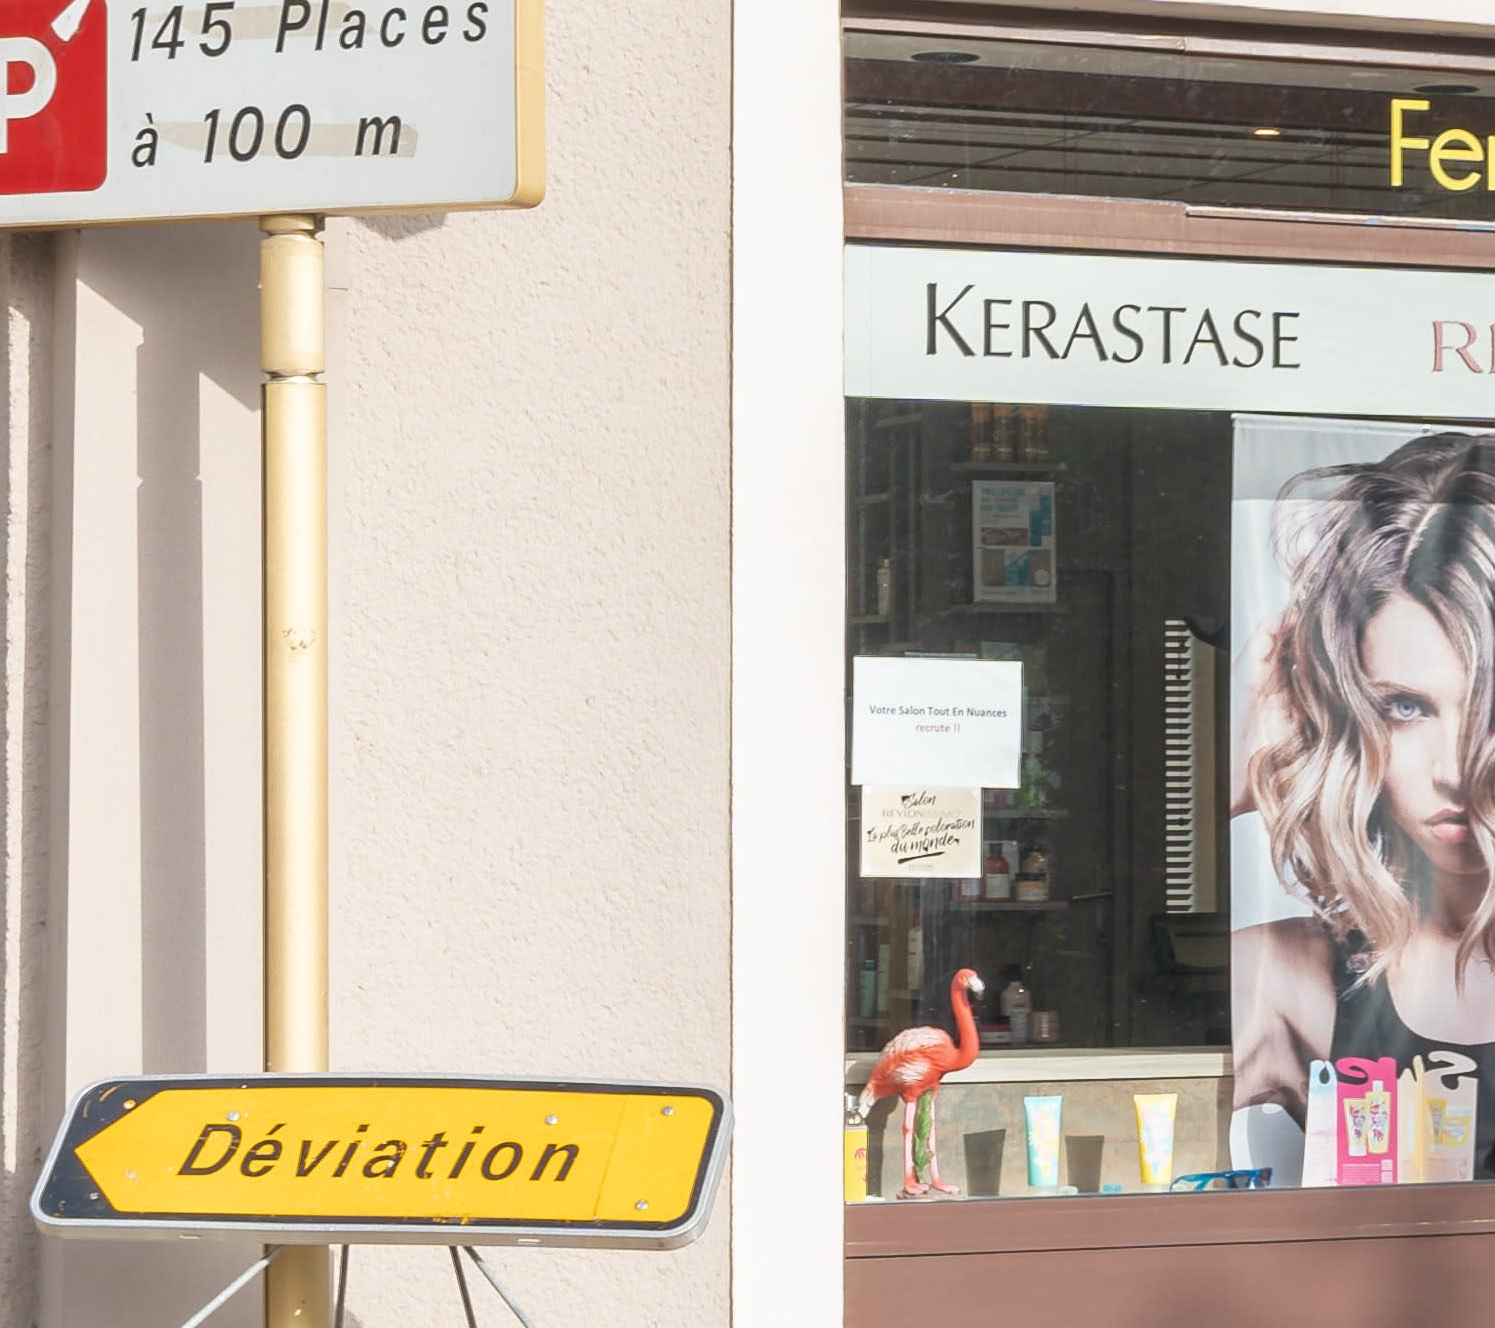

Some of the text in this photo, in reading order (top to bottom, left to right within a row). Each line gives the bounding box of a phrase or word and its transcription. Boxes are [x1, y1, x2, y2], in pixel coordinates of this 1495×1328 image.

[129, 0, 236, 63] 145
[131, 103, 403, 168] à 100 m
[925, 282, 1302, 370] KERASTASE
[869, 705, 1007, 718] Votre Salon Tout En Nuances
[915, 723, 950, 733] recrute
[901, 791, 937, 809] Salon
[177, 1122, 581, 1182] Déviation
